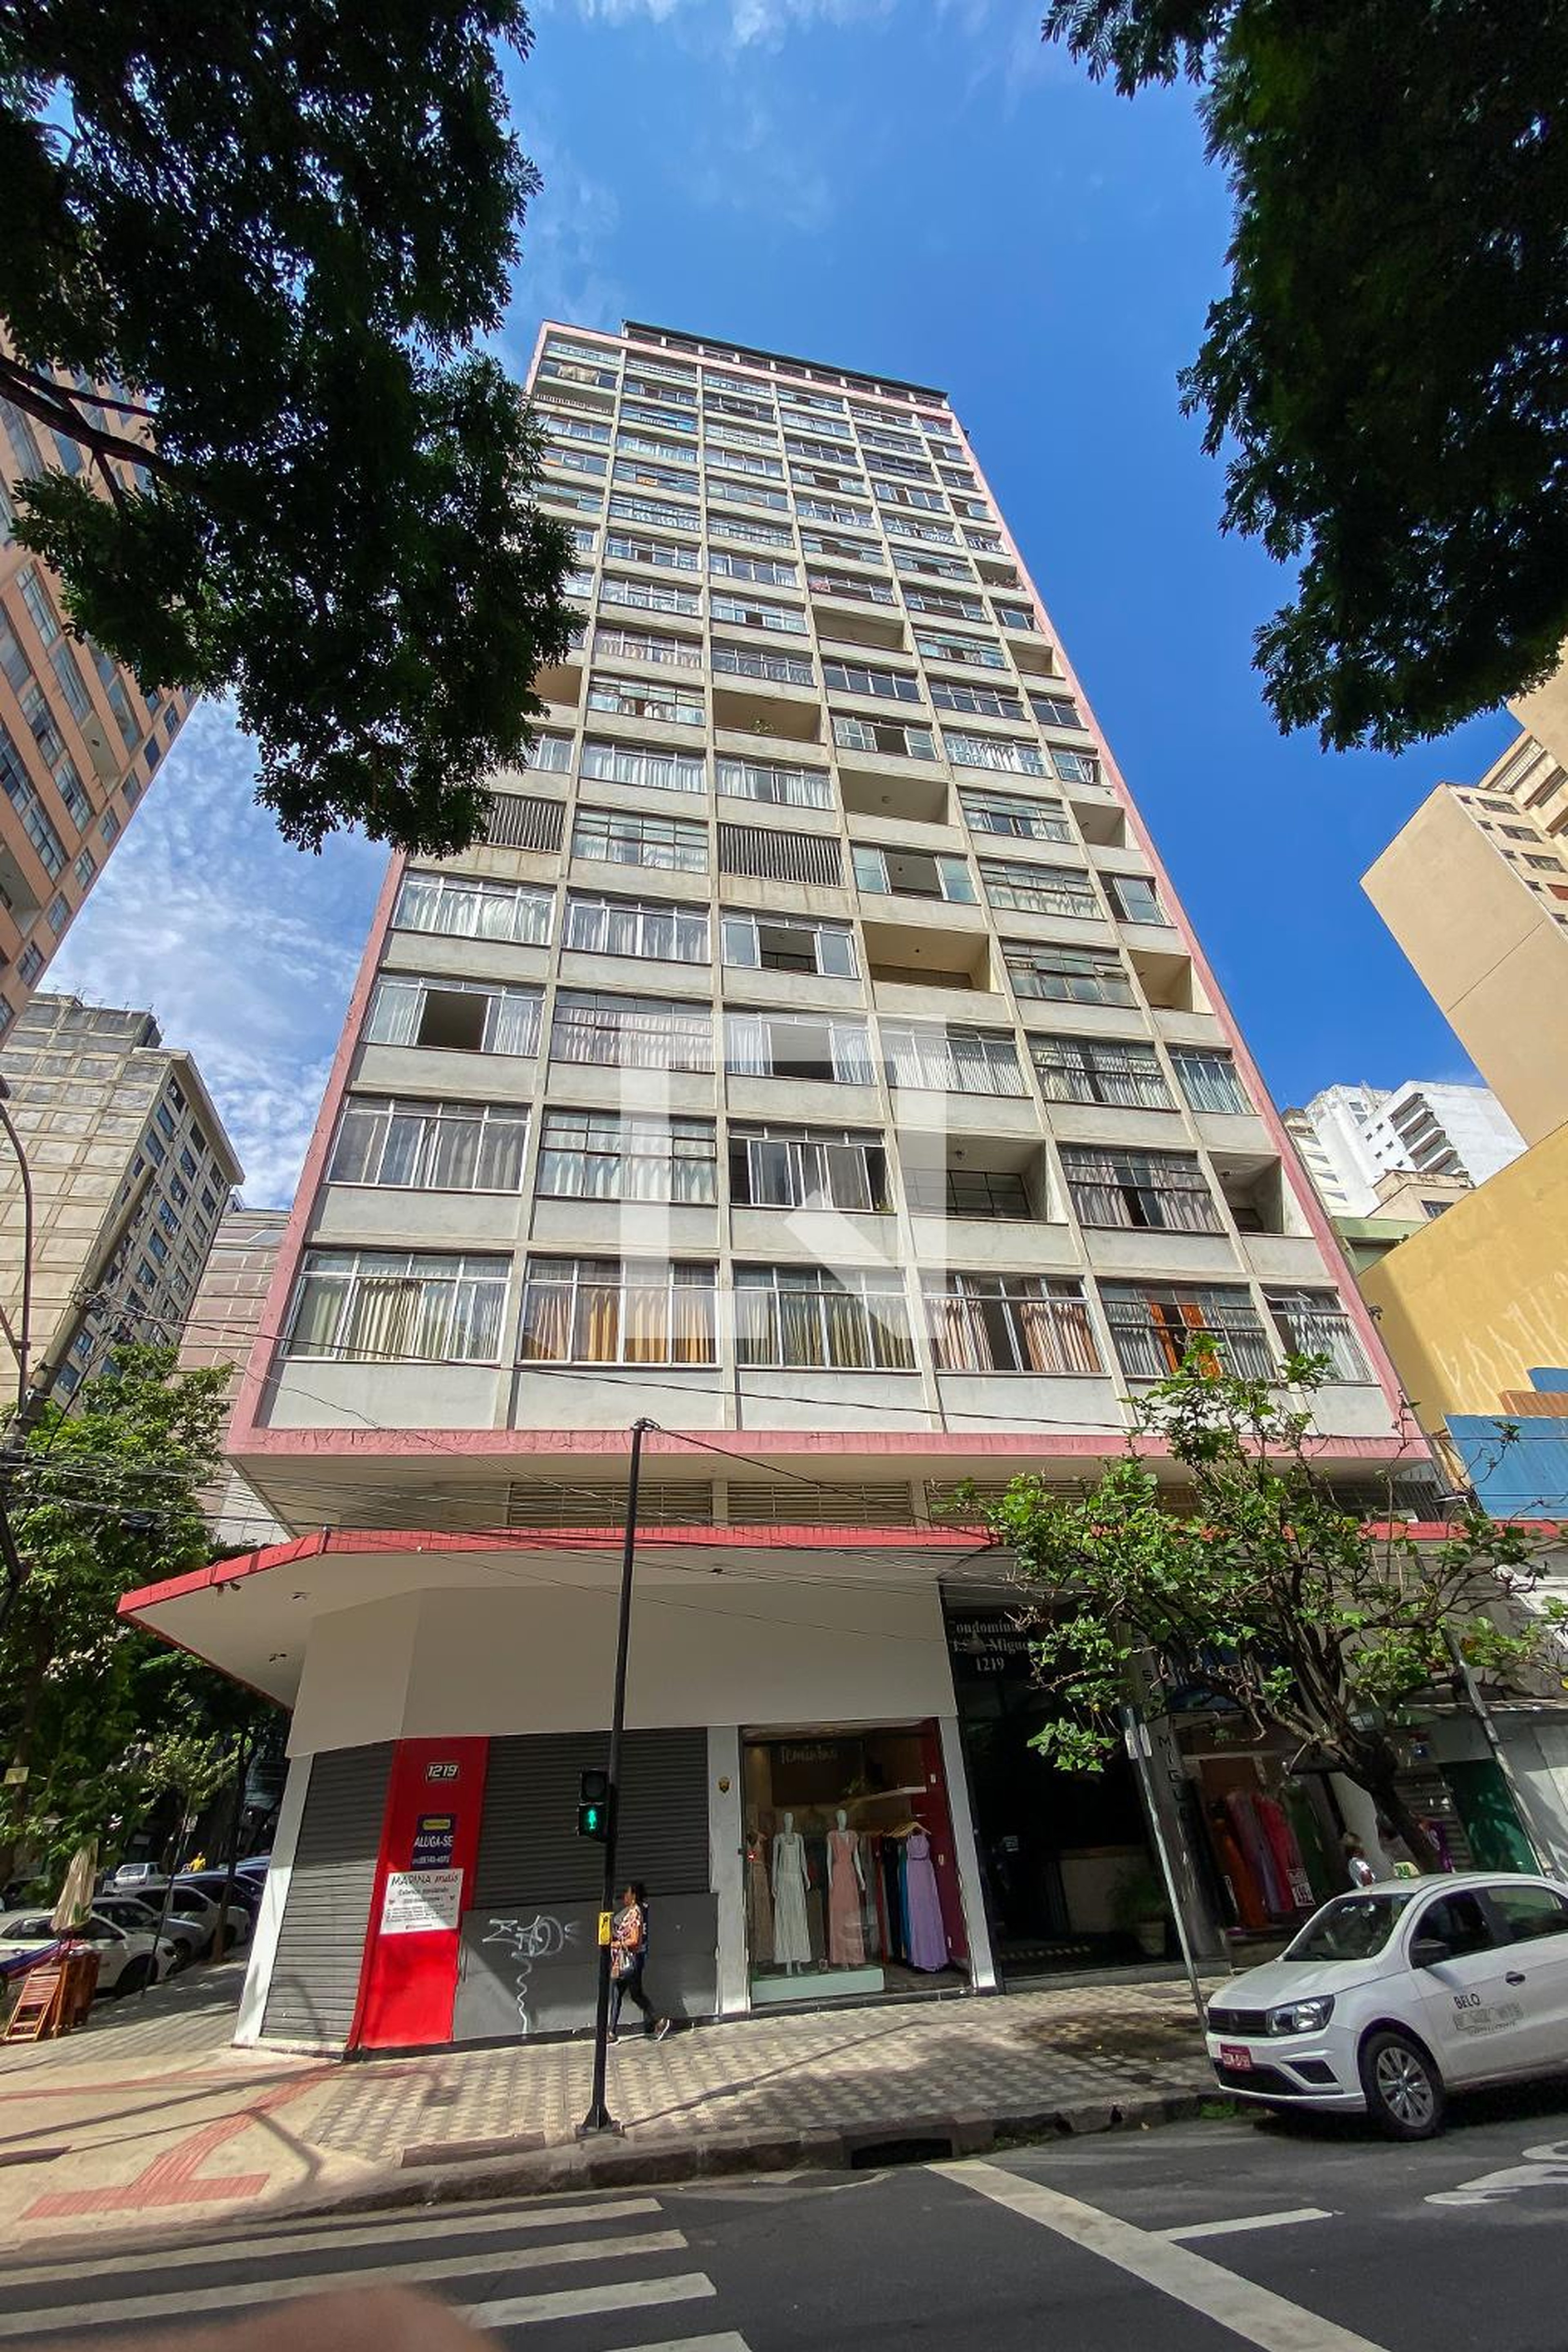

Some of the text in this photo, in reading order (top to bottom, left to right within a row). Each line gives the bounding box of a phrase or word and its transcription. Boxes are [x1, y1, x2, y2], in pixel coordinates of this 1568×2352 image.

[975, 1656, 1005, 1671] 1219
[428, 1764, 459, 1777] 1219
[414, 1835, 454, 1848] ALUGA-SE
[1453, 1993, 1481, 2009] BELO
